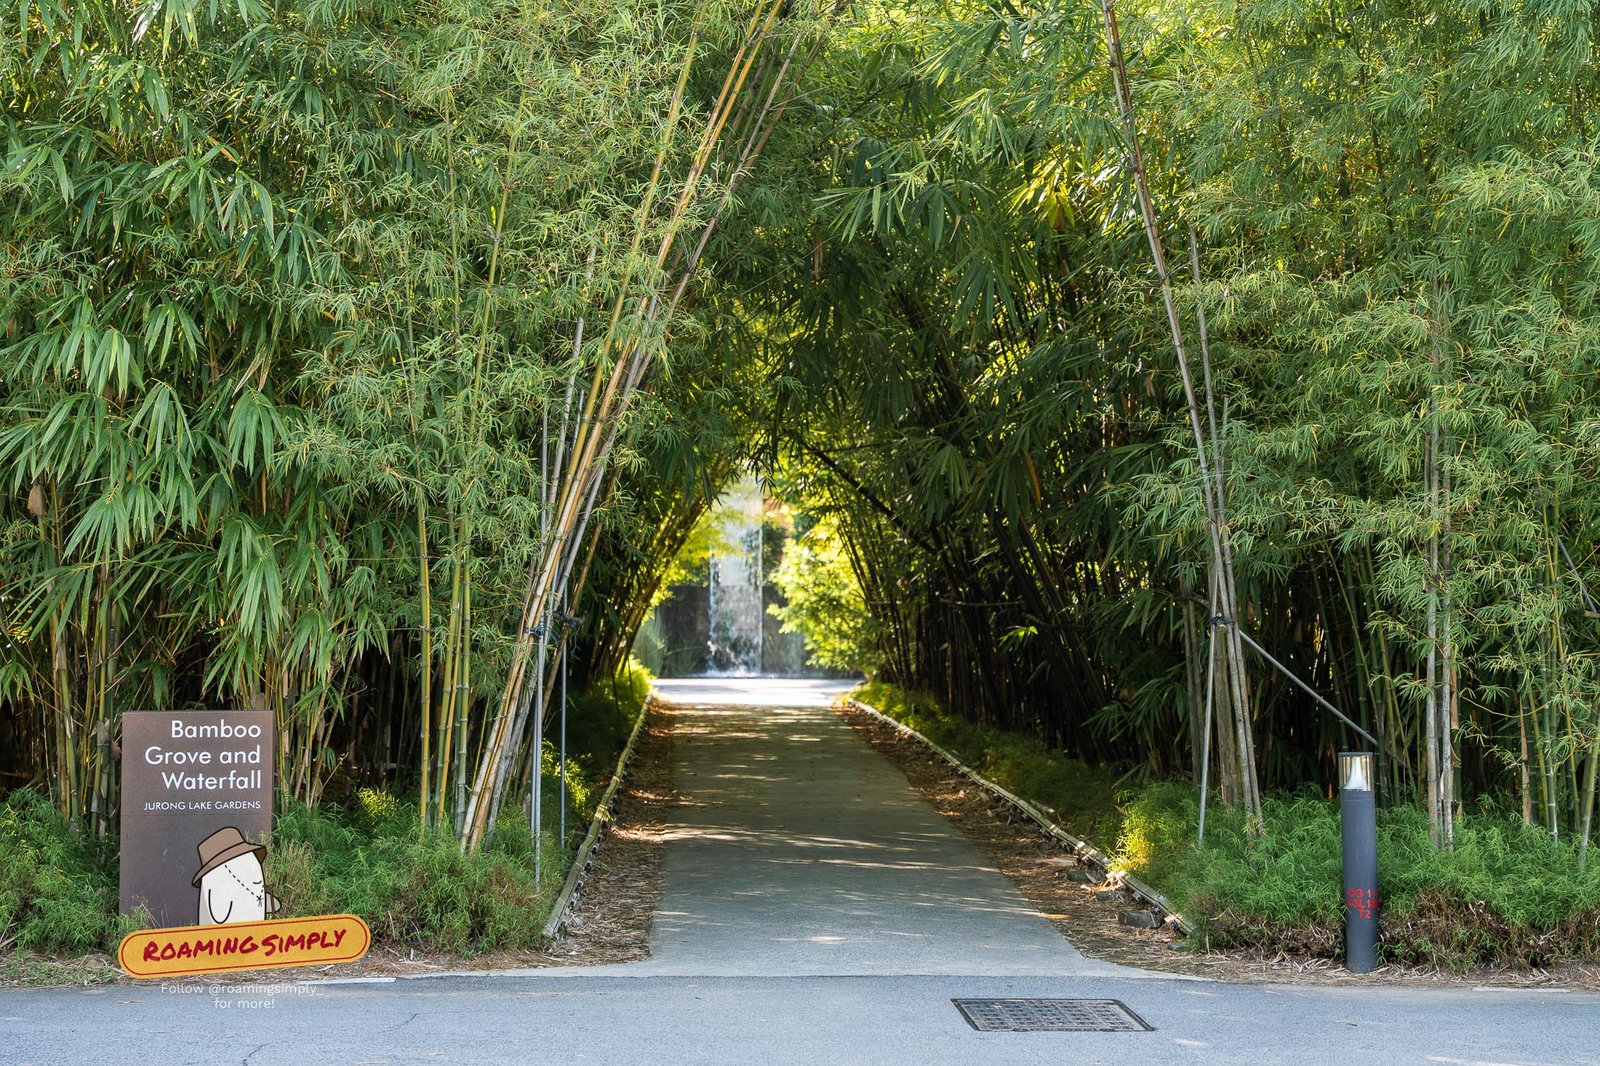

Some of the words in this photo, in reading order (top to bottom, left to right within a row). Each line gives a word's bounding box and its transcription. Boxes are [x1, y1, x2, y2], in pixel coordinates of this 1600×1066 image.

[171, 719, 261, 738] Bamboo
[145, 746, 212, 765] Grove
[219, 745, 261, 764] and
[161, 770, 261, 789] Waterfall
[144, 801, 186, 811] JURONG
[188, 801, 212, 810] LAKE
[214, 800, 261, 810] GARDENS
[1358, 909, 1371, 920] T2
